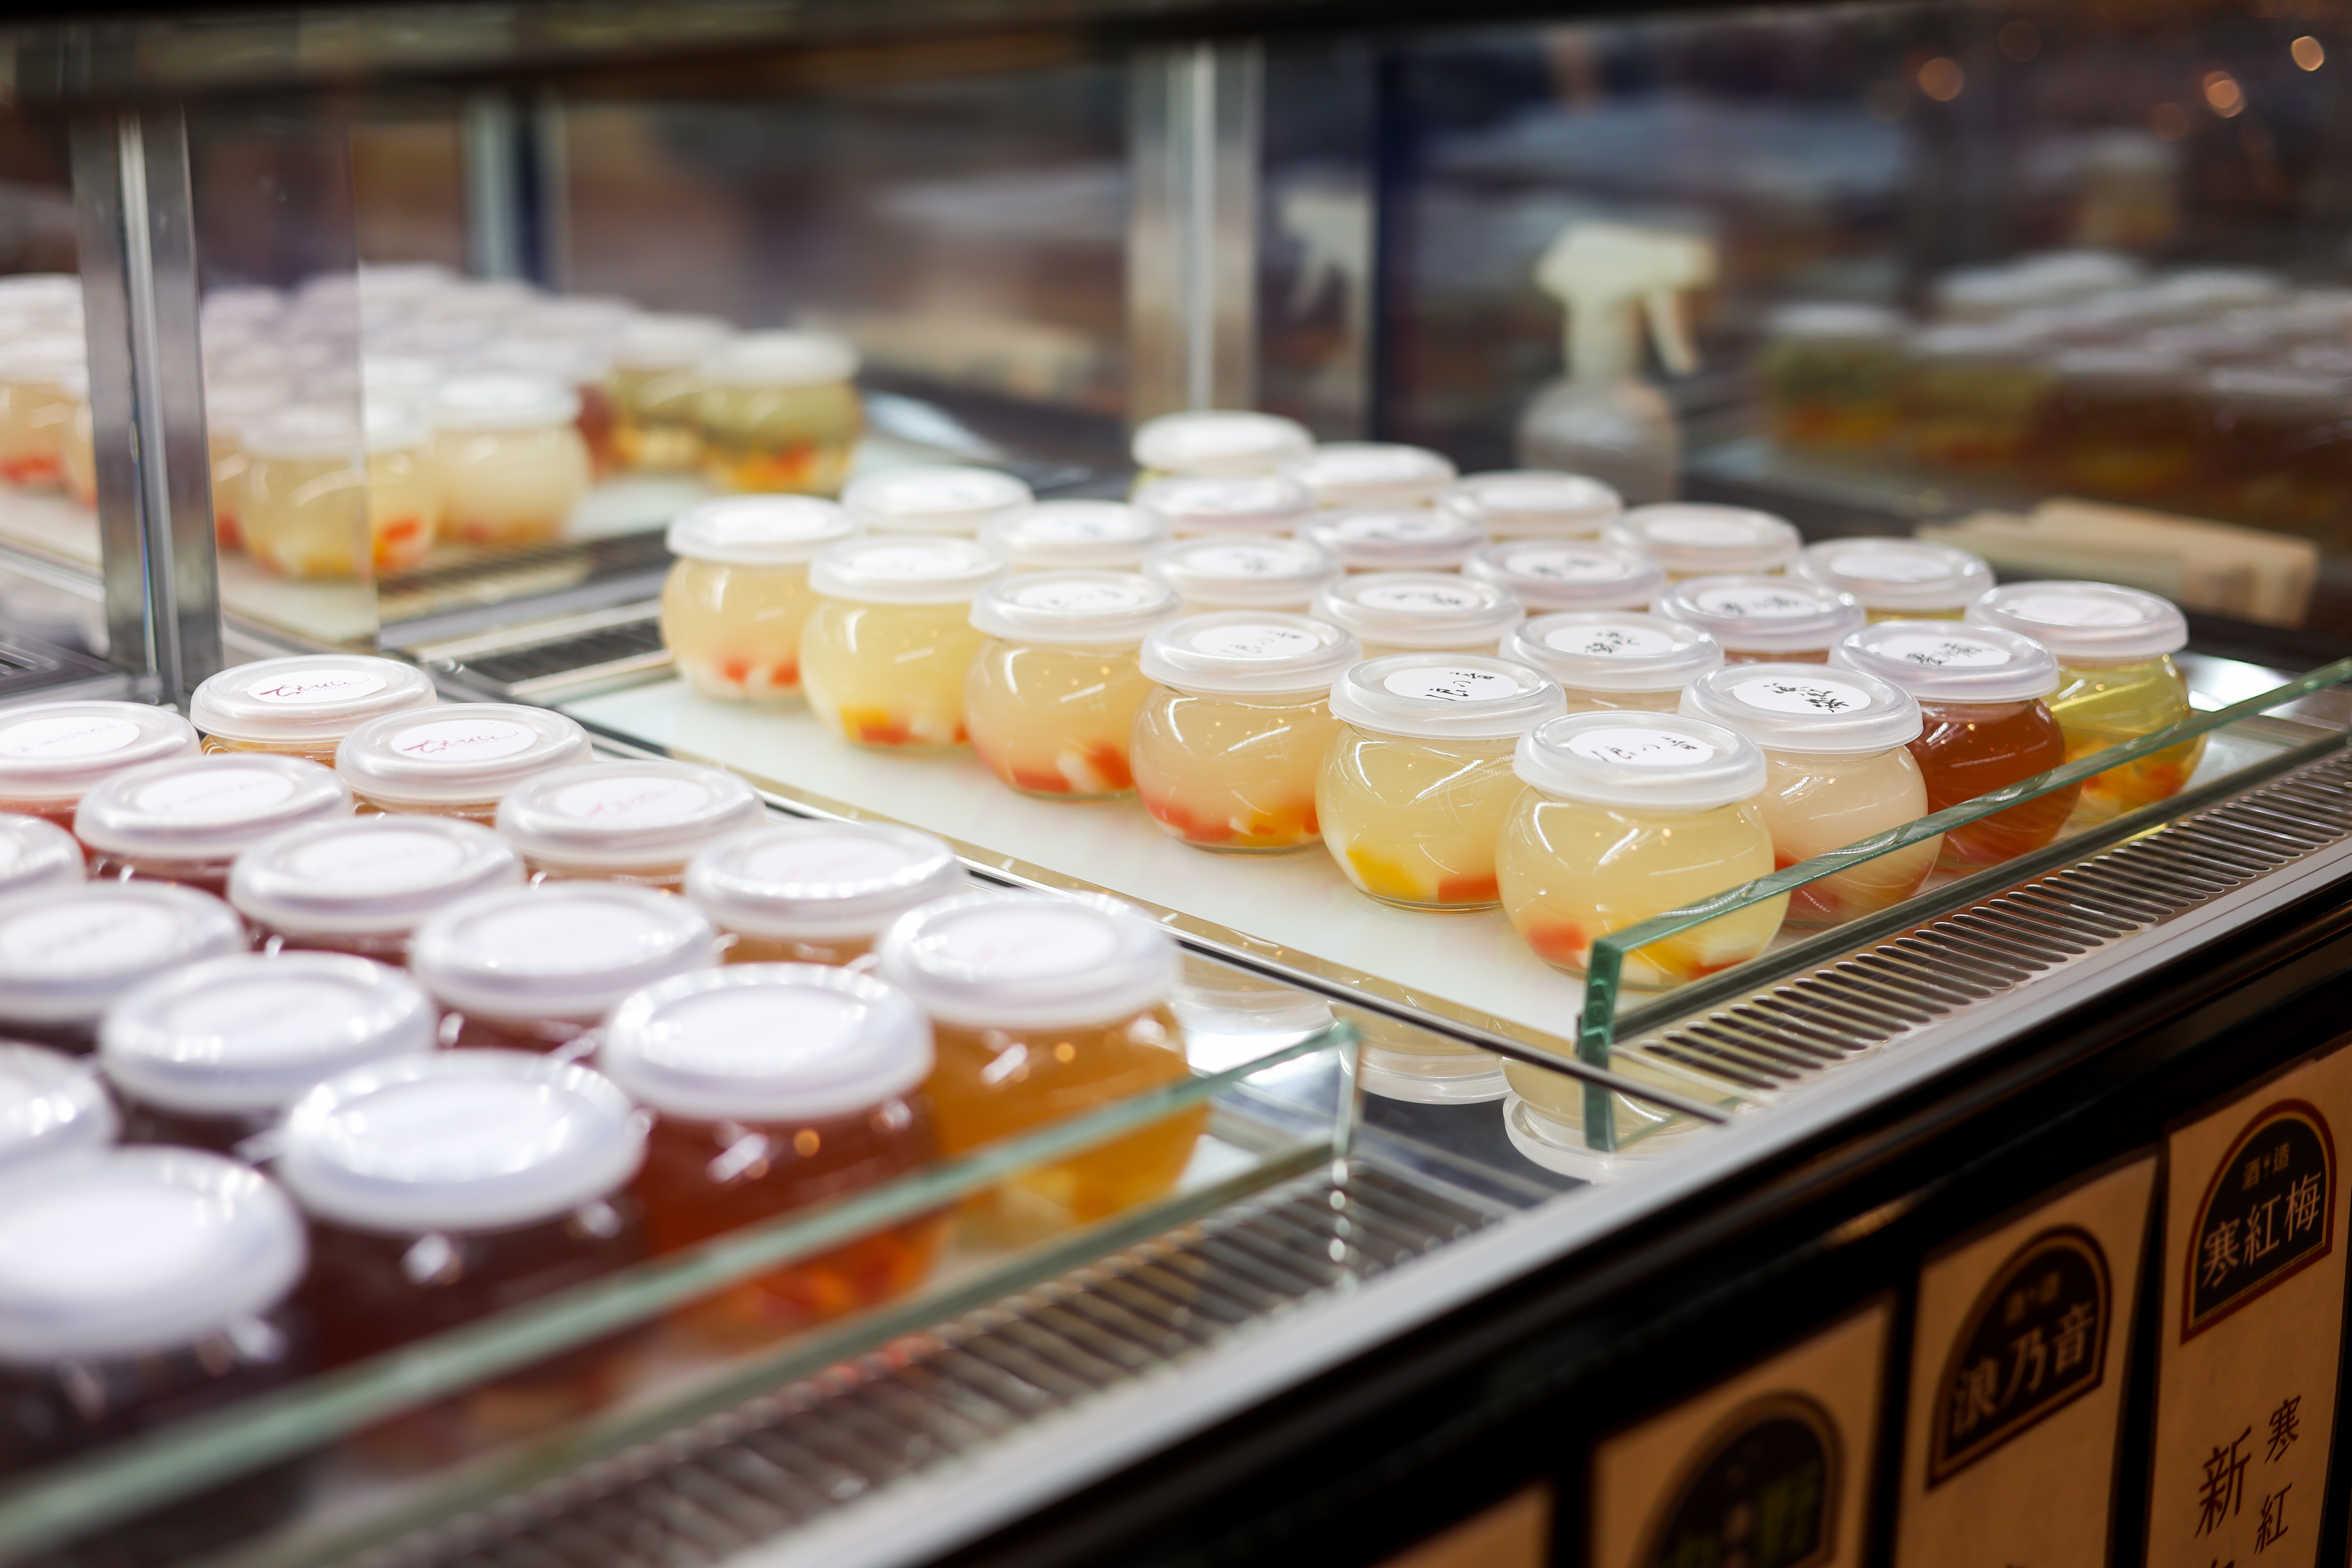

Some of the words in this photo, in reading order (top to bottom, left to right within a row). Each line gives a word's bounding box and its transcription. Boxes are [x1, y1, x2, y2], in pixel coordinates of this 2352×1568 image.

[2201, 1171, 2322, 1290] 寒紅梅
[1952, 1300, 2096, 1439] 浪乃音
[2195, 1425, 2252, 1568] 新
[2254, 1394, 2301, 1555] 寒紅
